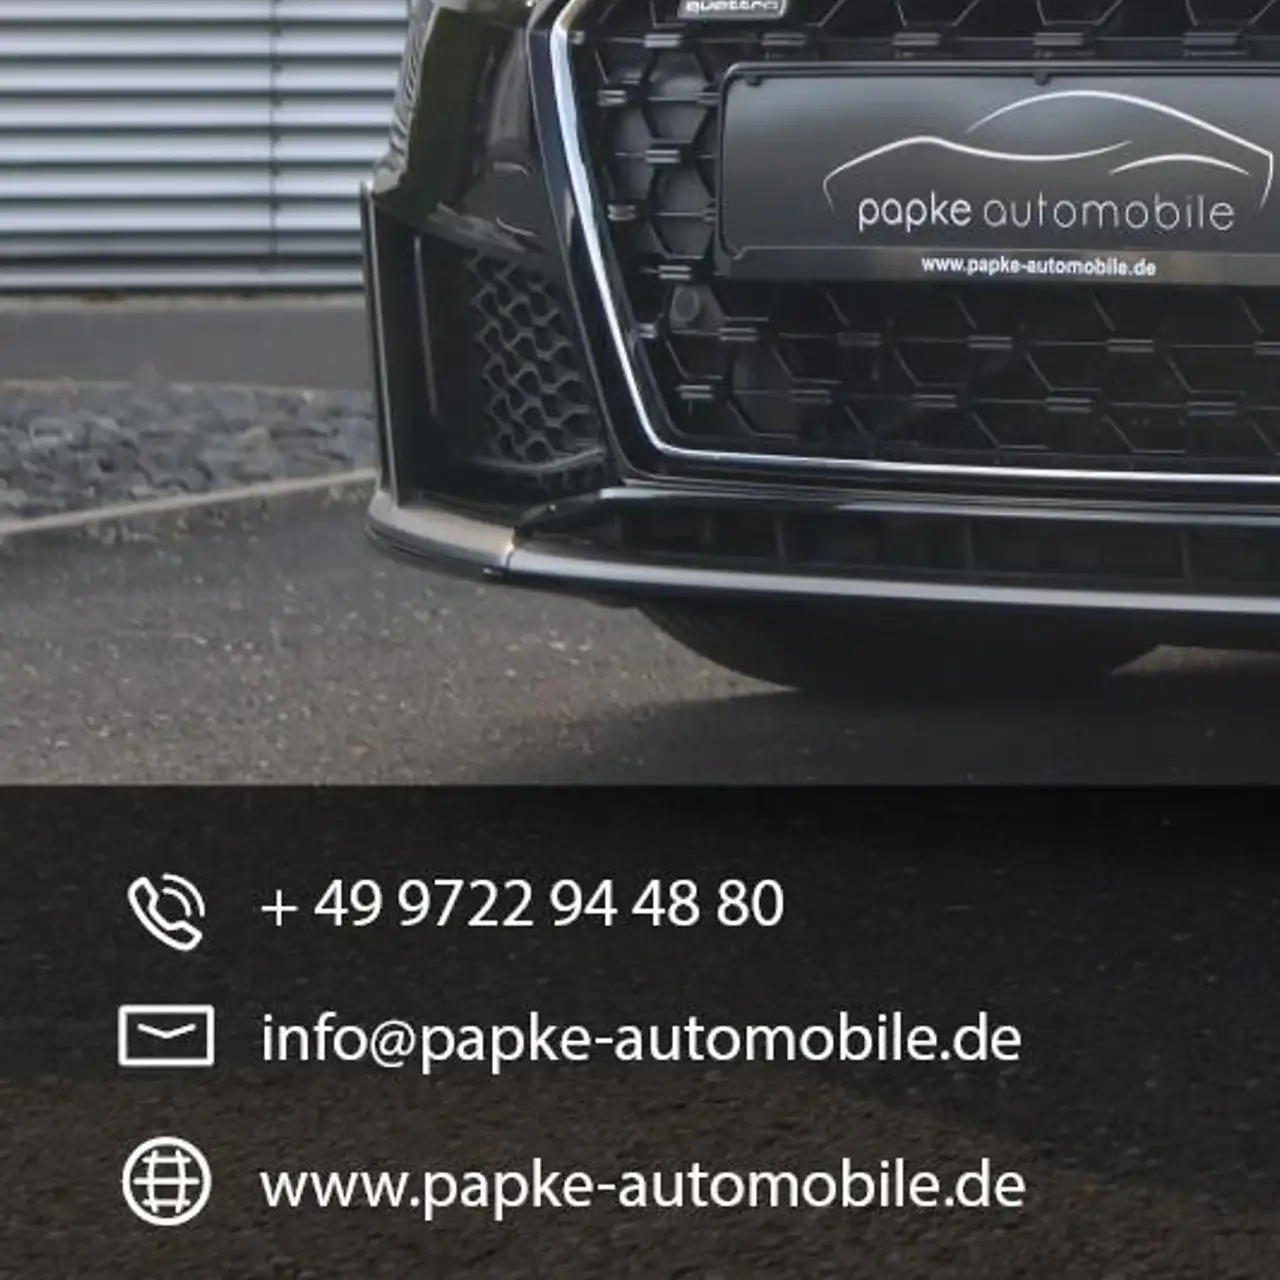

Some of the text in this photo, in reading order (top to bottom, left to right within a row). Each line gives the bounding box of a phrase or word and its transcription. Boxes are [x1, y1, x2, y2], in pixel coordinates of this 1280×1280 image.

[858, 190, 1235, 233] papke automobile
[920, 254, 1158, 278] www.papke-automobile.de
